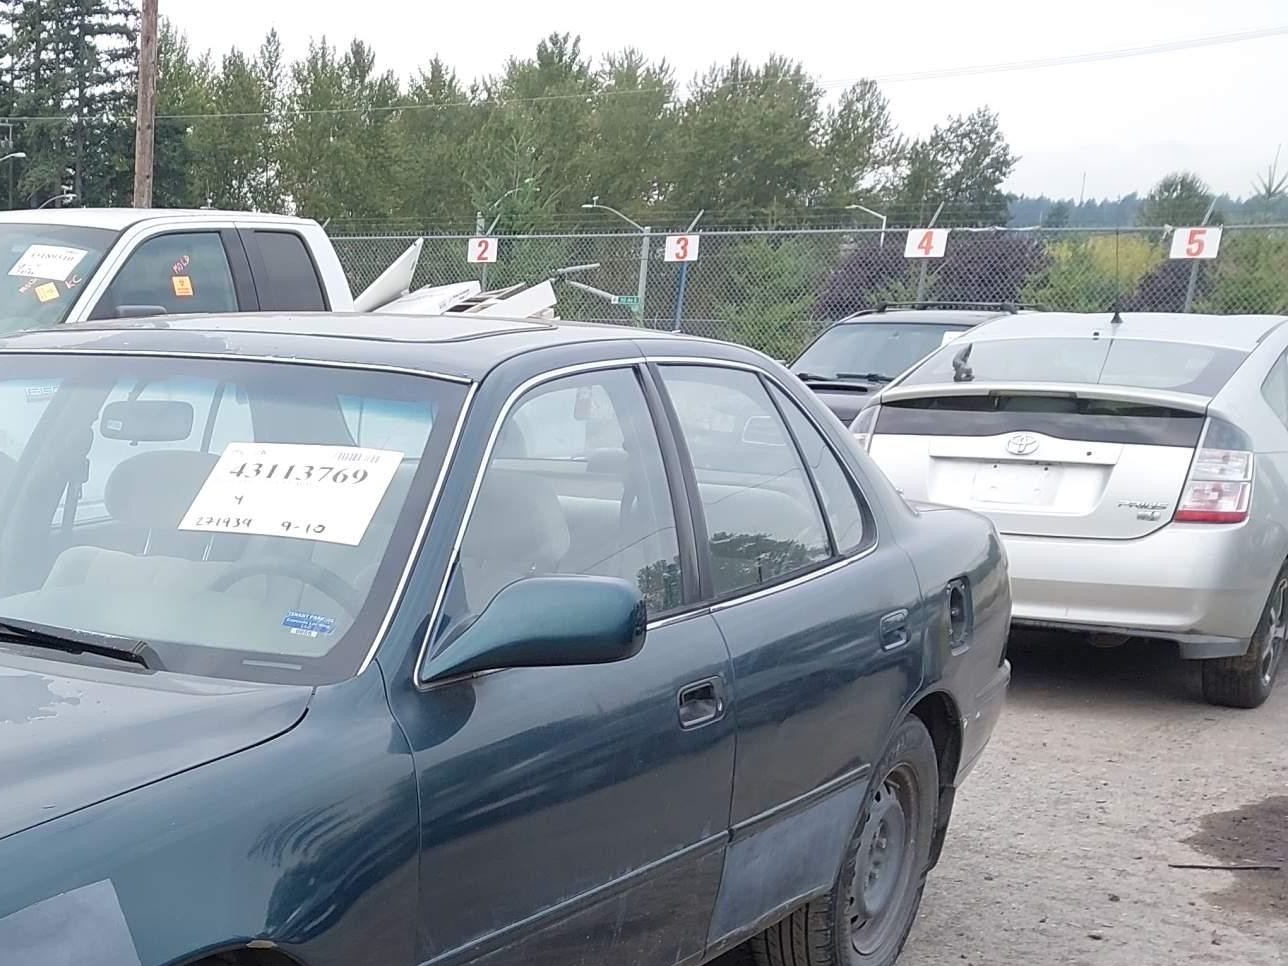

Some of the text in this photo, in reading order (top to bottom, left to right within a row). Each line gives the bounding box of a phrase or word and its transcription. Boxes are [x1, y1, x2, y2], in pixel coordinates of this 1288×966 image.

[477, 240, 490, 261] 2
[675, 237, 689, 260] 3
[918, 231, 934, 255] 4
[1187, 229, 1205, 257] 5
[229, 462, 369, 484] 43113769
